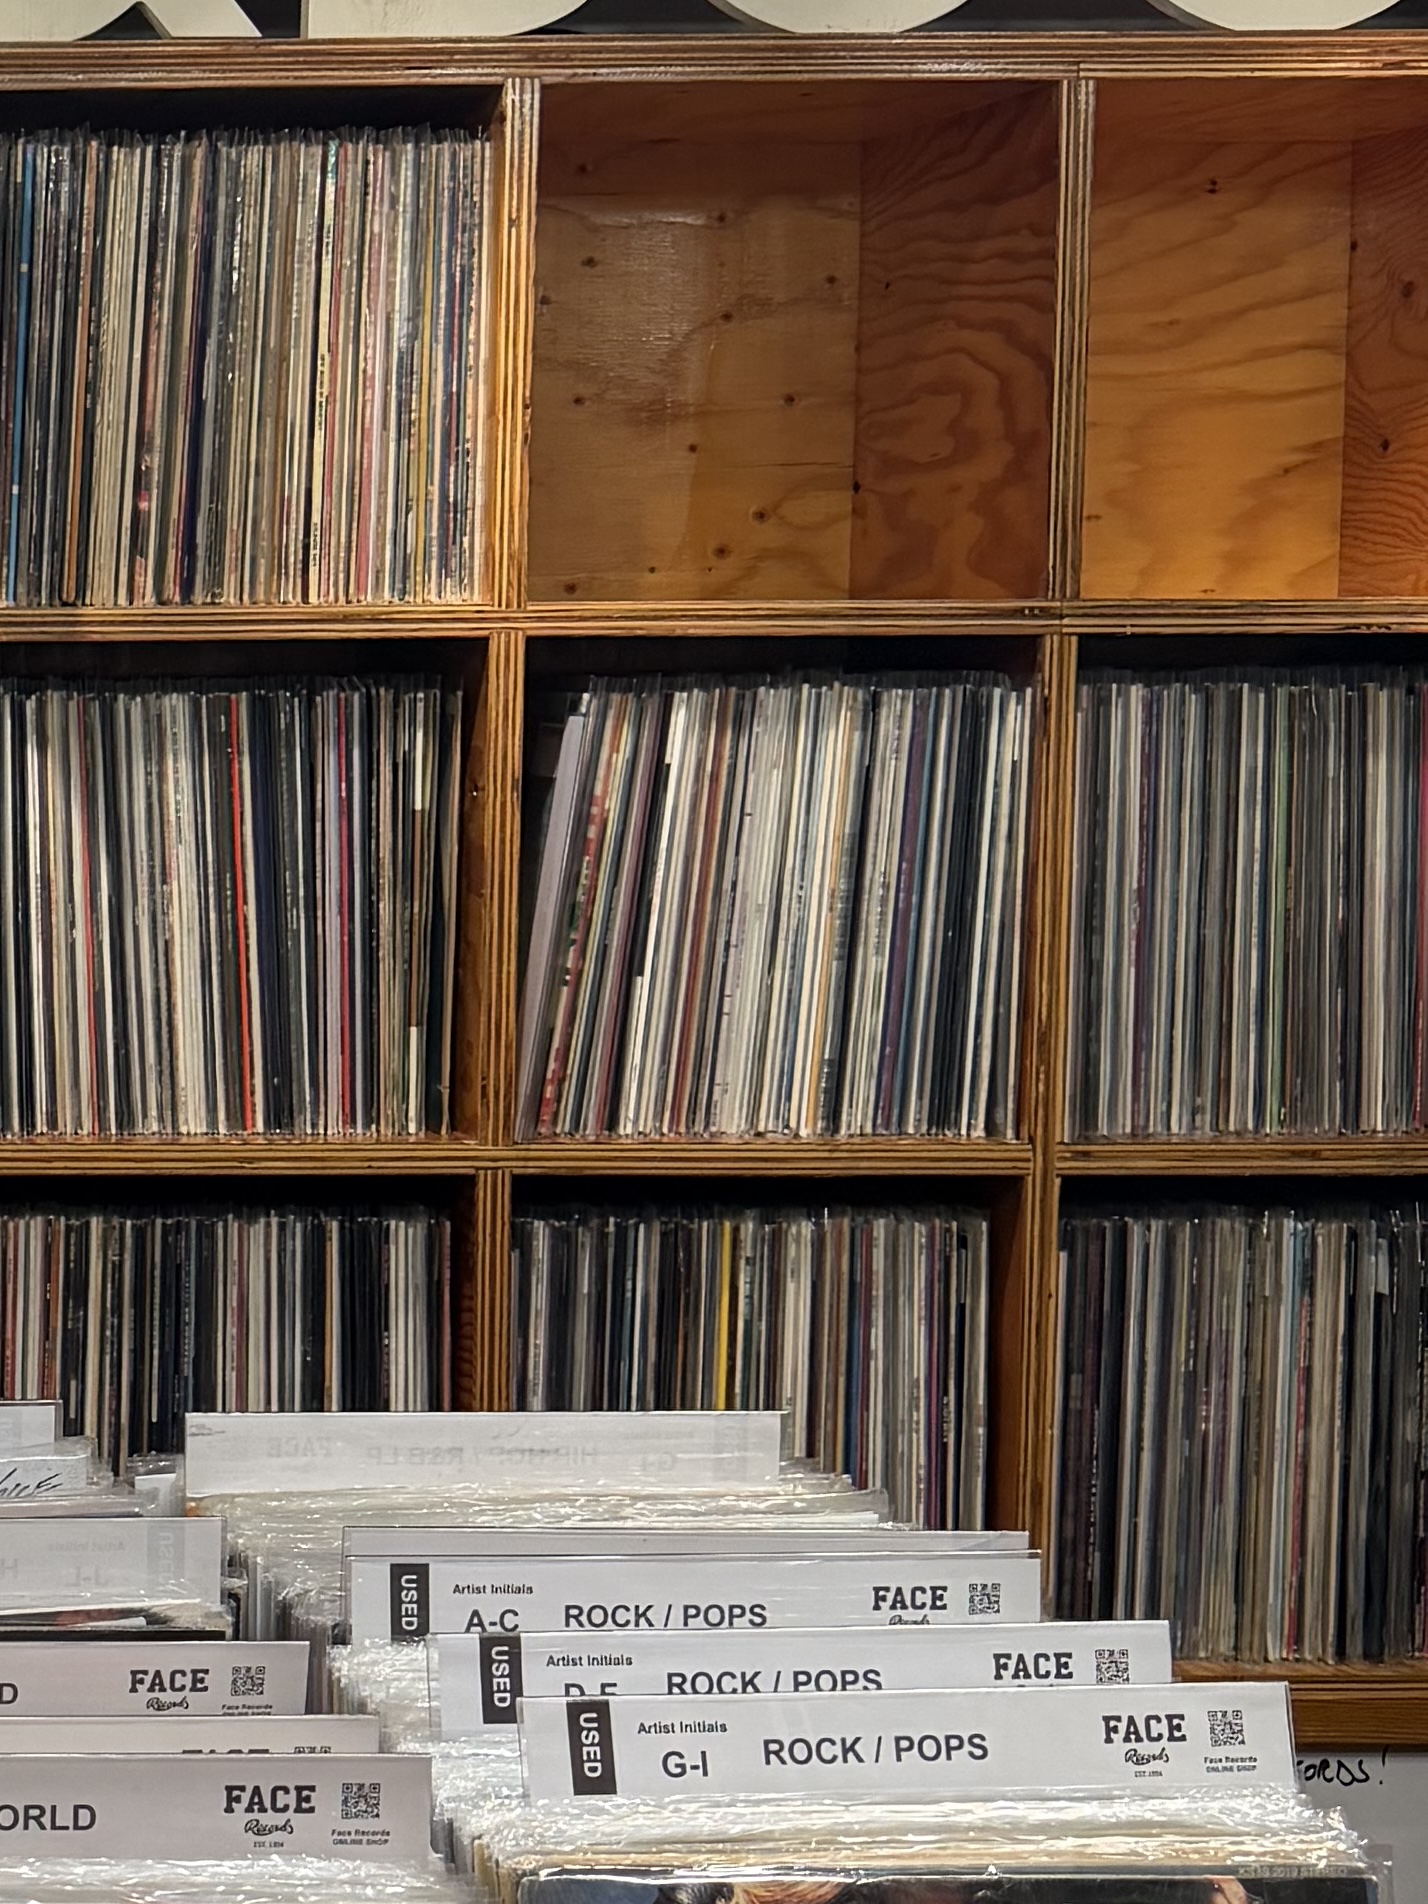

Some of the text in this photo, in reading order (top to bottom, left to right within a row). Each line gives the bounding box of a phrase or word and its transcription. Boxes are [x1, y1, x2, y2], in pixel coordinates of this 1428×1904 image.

[400, 1574, 417, 1631] USED
[452, 1583, 534, 1595] Artist Initials
[872, 1585, 949, 1611] FACE
[464, 1609, 520, 1633] A-C
[564, 1603, 768, 1629] ROCK / POPS
[546, 1654, 634, 1667] Artist Initials
[992, 1652, 1074, 1680] FACE
[129, 1668, 210, 1694] FACE
[490, 1645, 511, 1709] USED
[666, 1669, 883, 1695] ROCK / POPS
[637, 1721, 728, 1735] Artist Initials
[1101, 1713, 1187, 1744] FACE
[579, 1711, 602, 1779] USED
[763, 1733, 989, 1766] ROCK / POPS
[661, 1750, 709, 1778] G-I
[223, 1784, 317, 1815] FACE
